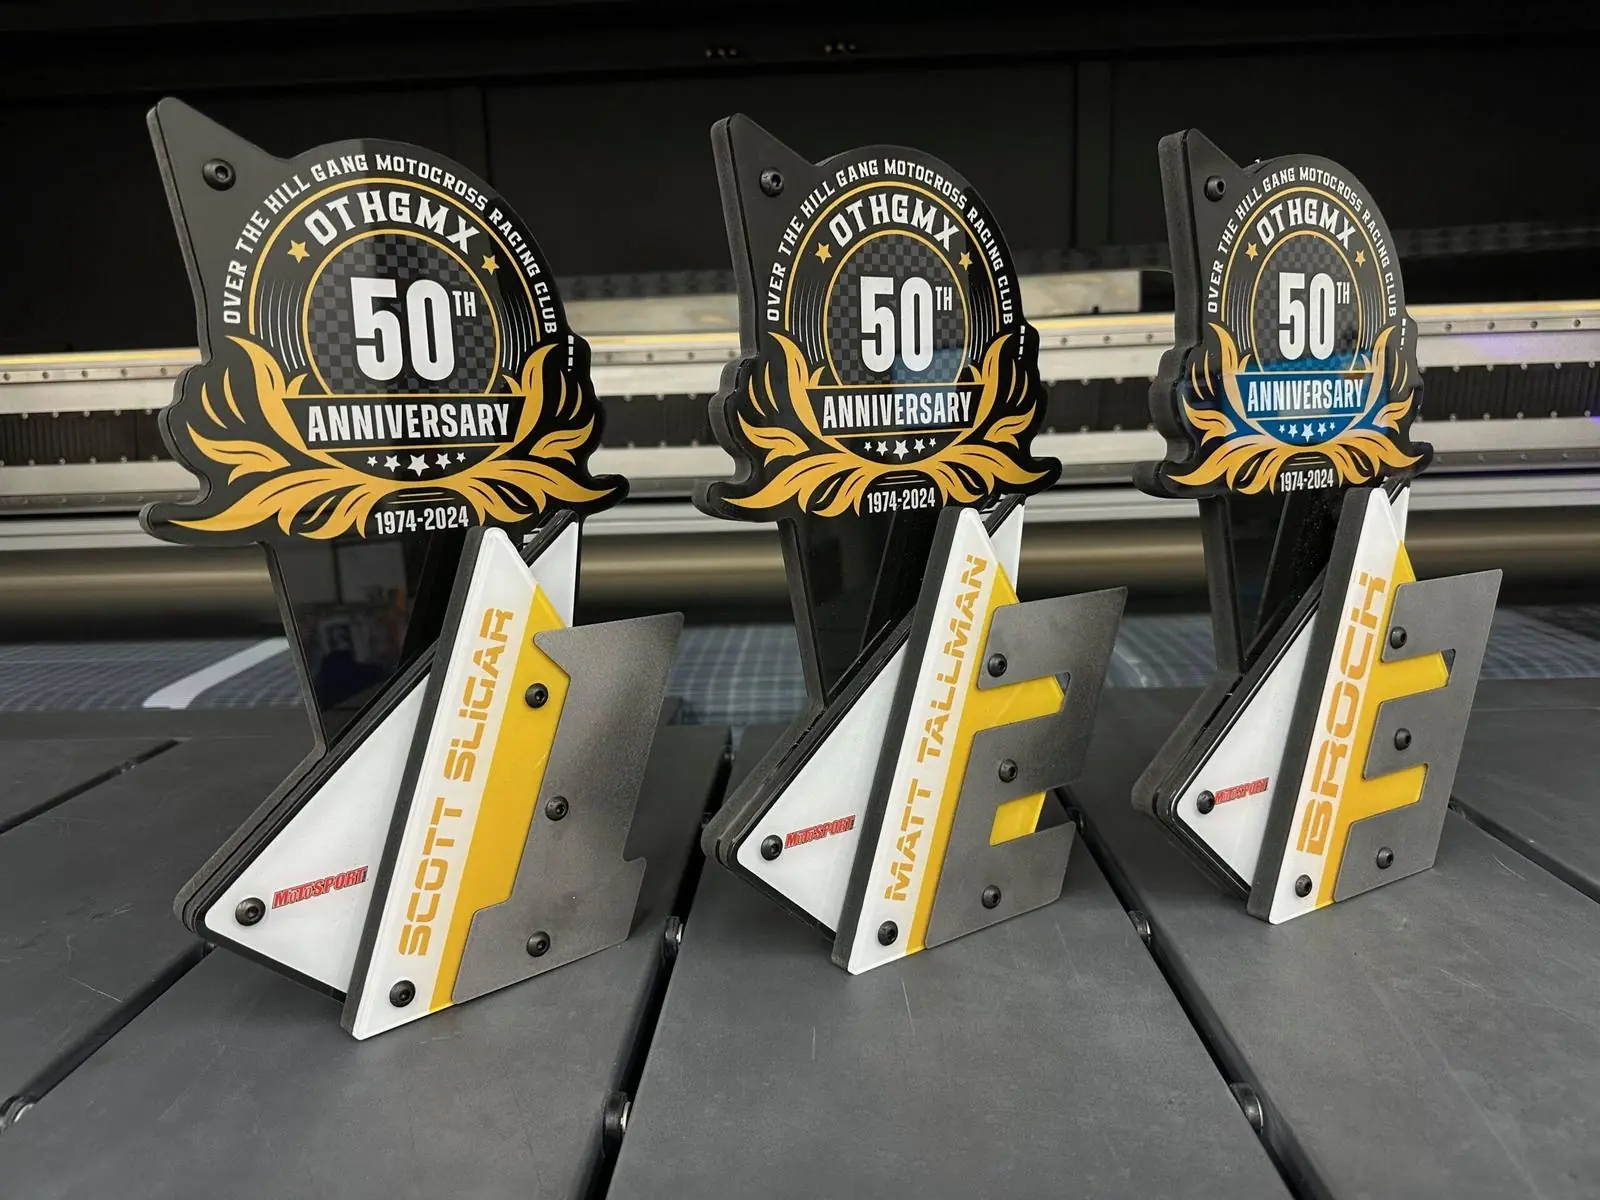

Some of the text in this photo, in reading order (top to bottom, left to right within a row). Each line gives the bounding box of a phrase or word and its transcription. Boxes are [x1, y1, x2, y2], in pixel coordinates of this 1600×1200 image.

[224, 154, 557, 334] OVER THE HILL GANG MOTOCROSS RACING CLUB
[304, 190, 481, 255] OTHGMX
[767, 159, 1013, 325] OVER THE HILL GANG MOTOCROSS RACING CLUB
[828, 193, 960, 252] OTHGMX
[1208, 166, 1397, 317] OVER THE HILL GANG MOTOCROSS RACING CLUB
[1256, 198, 1356, 250] OTHGMX
[308, 403, 510, 442] ANNIVERSARY
[823, 391, 973, 429] ANNIVERSARY
[1247, 379, 1364, 412] ANNIVERSARY
[867, 487, 936, 514] 1974-2024
[1280, 468, 1334, 492] 1974-2024
[374, 505, 469, 535] 1974-2024
[885, 554, 988, 901] MATT TALLMAN
[1296, 571, 1388, 856] BROCK
[399, 607, 514, 956] SCOTT SLIGAR
